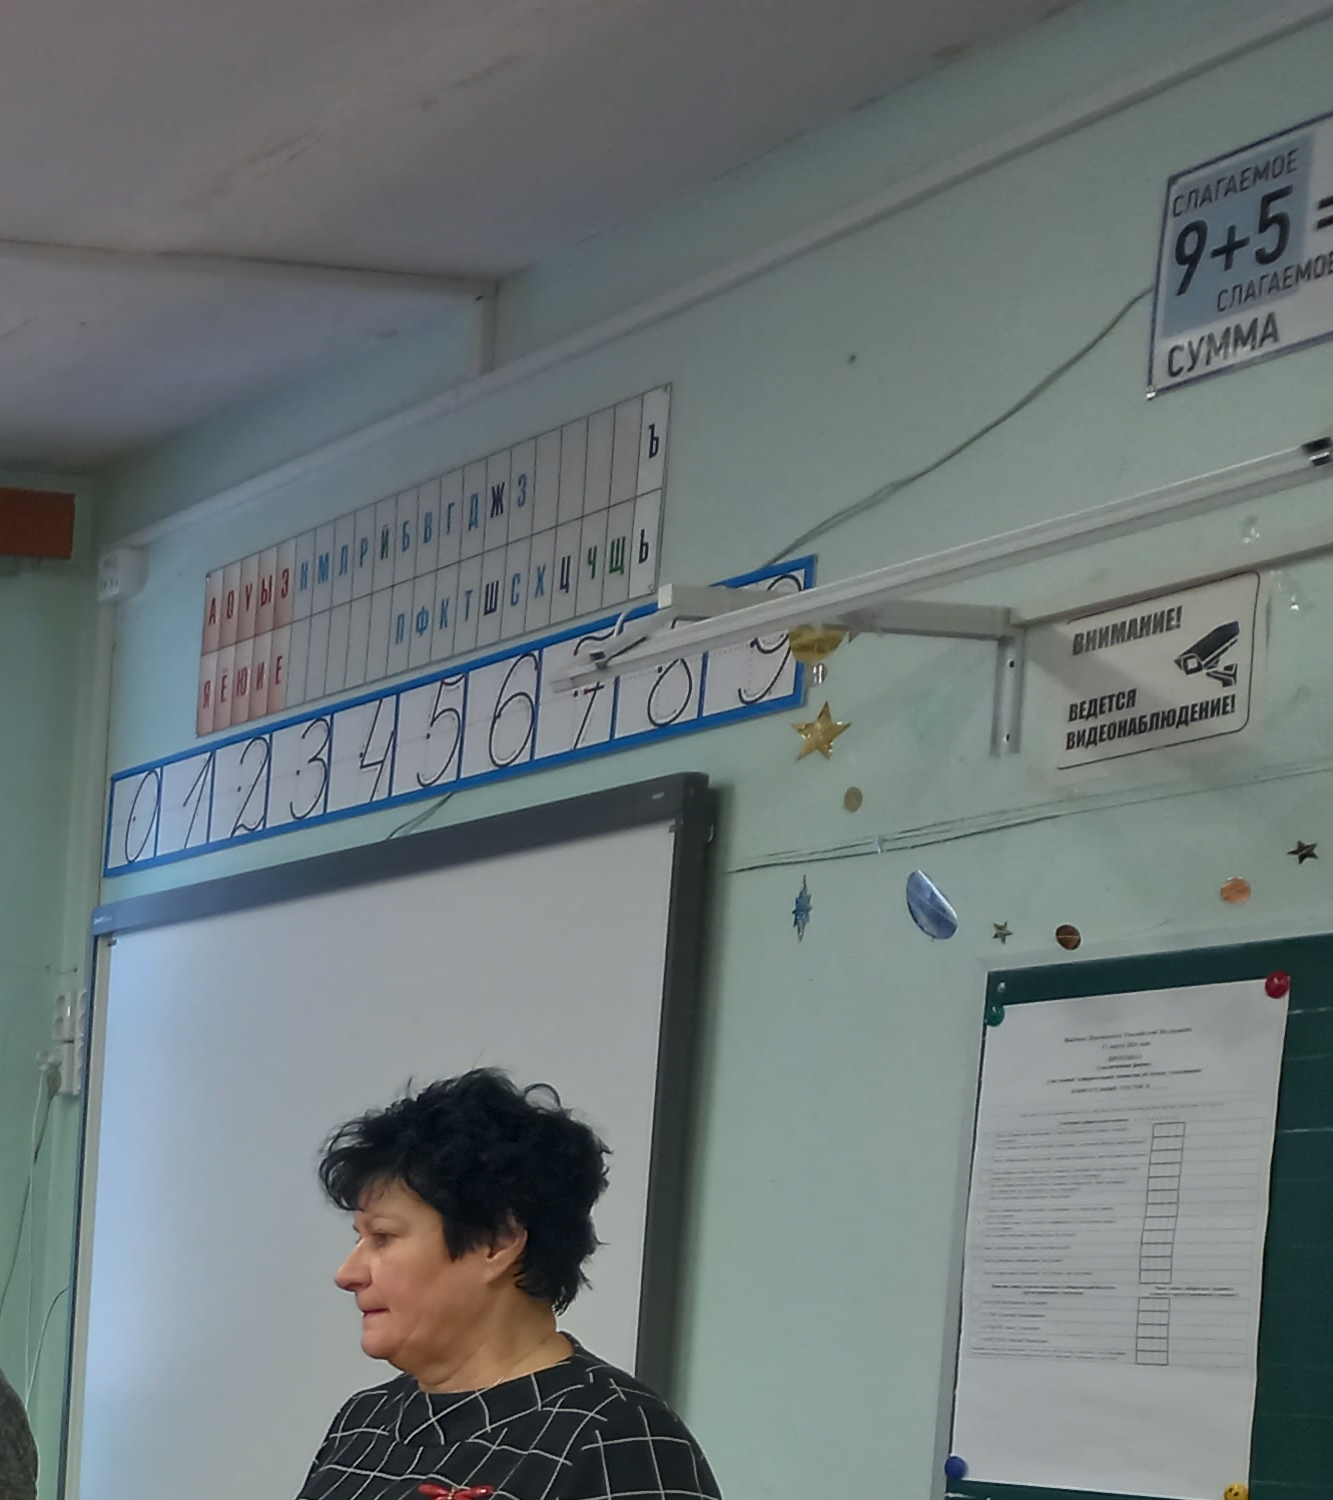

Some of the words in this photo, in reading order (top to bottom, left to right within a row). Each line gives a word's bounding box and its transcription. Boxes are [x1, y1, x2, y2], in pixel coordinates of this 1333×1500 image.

[1172, 149, 1300, 218] СЛАГАЕМОЕ
[1167, 311, 1280, 378] СУММА
[208, 597, 217, 626] А
[226, 590, 235, 620] О
[245, 582, 254, 612] У
[260, 574, 274, 607] Ы
[299, 560, 309, 592] Н
[317, 552, 330, 585] М
[338, 544, 349, 577] Л
[359, 537, 369, 568] Р
[380, 524, 390, 561] Й
[402, 519, 411, 553] Б
[423, 511, 433, 544] В
[446, 501, 455, 535] Г
[468, 492, 480, 532] Д
[490, 482, 506, 519] Ж
[517, 473, 528, 508] З
[648, 422, 660, 459] Ъ
[202, 680, 212, 709] Я
[220, 667, 229, 704] Ё
[236, 666, 249, 698] Ю
[256, 661, 265, 691] И
[395, 612, 406, 645] П
[415, 605, 429, 637] Ф
[439, 597, 450, 630] К
[463, 589, 474, 622] Т
[483, 579, 500, 617] Ш
[510, 571, 521, 607] С
[534, 563, 547, 599] Х
[559, 555, 572, 594] Ц
[587, 545, 598, 580] Ч
[608, 535, 626, 576] Щ
[638, 528, 650, 565] Ь
[1072, 605, 1183, 655] ВНИМАНИЕ!
[1066, 694, 1237, 750] ВИДЕОНАБЛЮДЕНИЕ!
[1068, 688, 1137, 723] ВЕДЕТСЯ
[182, 750, 215, 849] 1
[231, 736, 271, 838] 2
[290, 718, 331, 820] 3
[360, 697, 395, 802] 4
[416, 673, 466, 788] 5
[488, 652, 540, 768] 6
